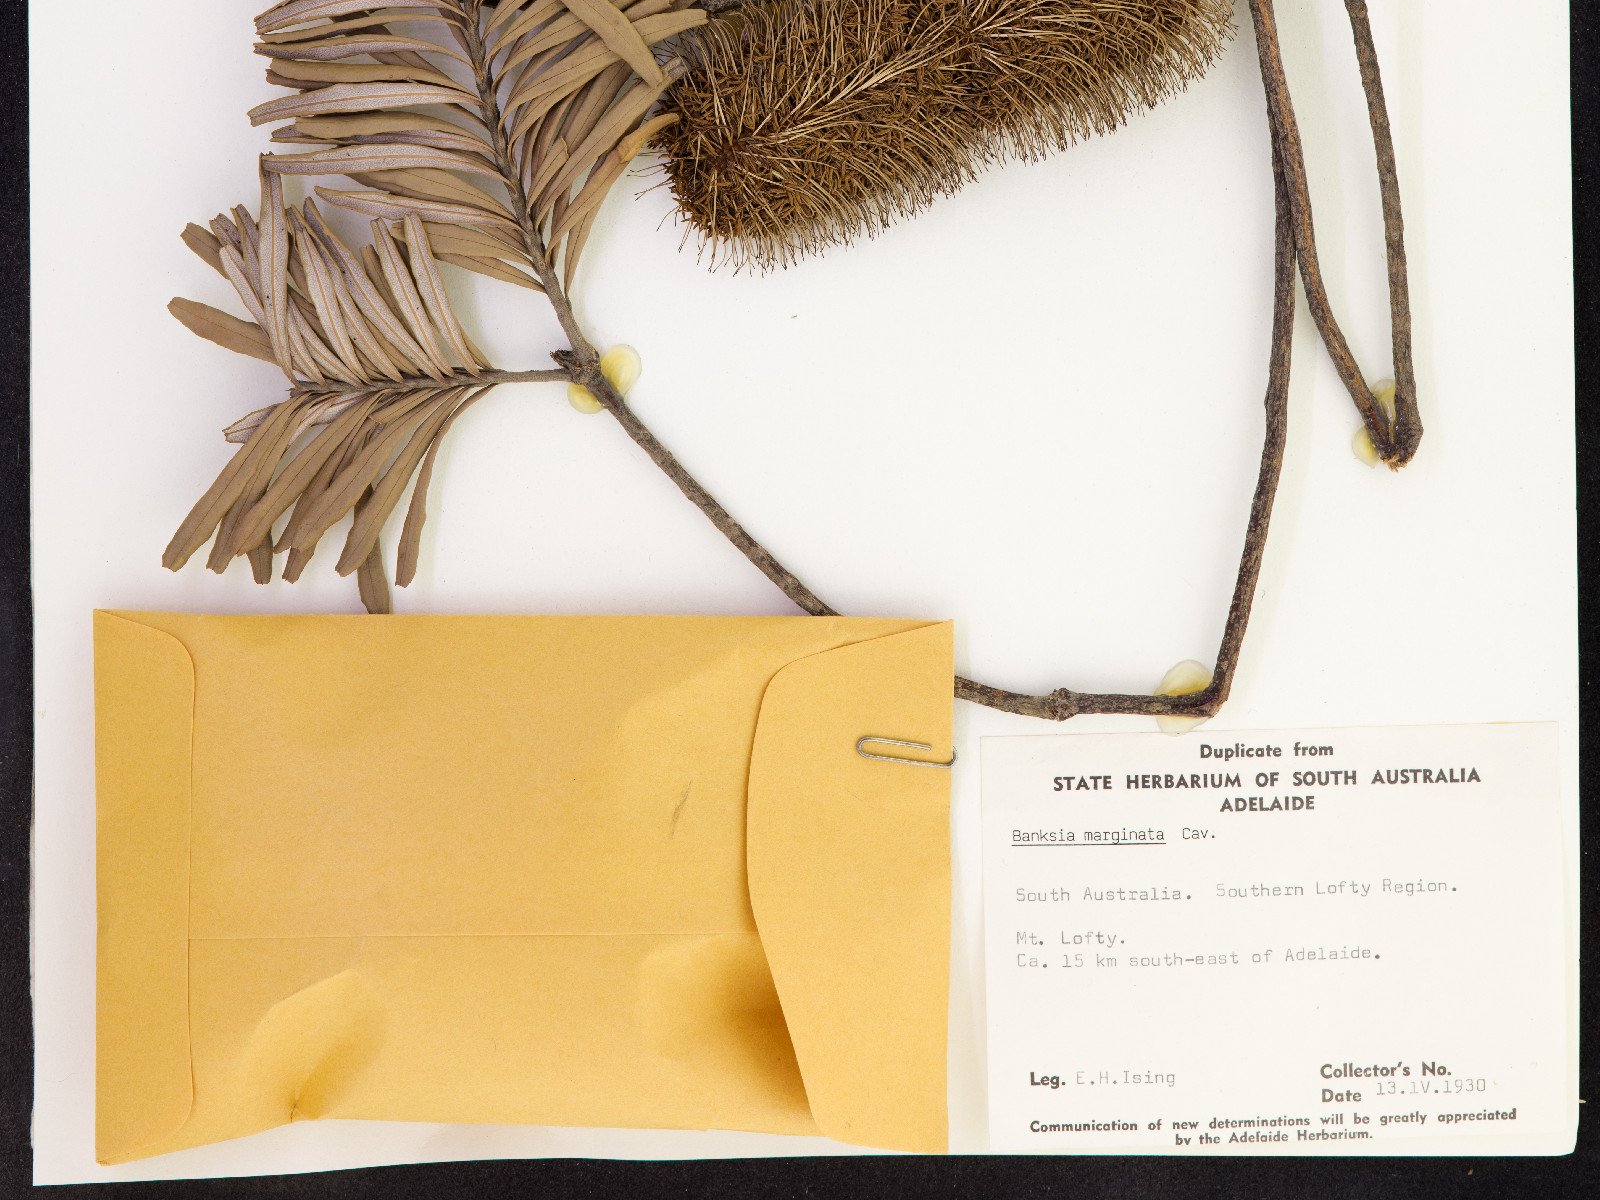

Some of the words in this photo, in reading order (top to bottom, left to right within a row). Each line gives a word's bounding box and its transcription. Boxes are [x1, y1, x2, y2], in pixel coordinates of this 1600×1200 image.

[1199, 742, 1282, 762] Duplicate
[1293, 741, 1334, 757] from
[1053, 775, 1113, 792] STATE
[1126, 772, 1242, 790] HERBARIUM
[1255, 771, 1280, 788] OF
[1292, 770, 1357, 787] SOUTH
[1370, 767, 1482, 785] AUSTRALIA
[1219, 795, 1315, 813] ADELAIDE
[1011, 828, 1077, 843] Banksia
[1082, 827, 1166, 845] marginata
[1182, 827, 1215, 840] Cav.
[1016, 887, 1070, 902] South
[1083, 886, 1192, 901] Australia.
[1216, 882, 1304, 898] Southern
[1315, 880, 1371, 900] Lofty
[1382, 878, 1458, 897] Region.
[1016, 931, 1045, 946] Mt.
[1061, 930, 1126, 949] Lofty.
[1017, 953, 1048, 969] Ca.
[1061, 953, 1084, 968] 15
[1095, 953, 1117, 968] km
[1129, 950, 1239, 967] south-east
[1251, 949, 1273, 964] of
[1285, 945, 1382, 962] Adelaide.
[1421, 1061, 1452, 1077] No.
[1029, 1071, 1067, 1090] Leg.
[1076, 1070, 1176, 1088] E.H.Ising
[1321, 1088, 1362, 1103] Date
[1029, 1119, 1138, 1133] Communication
[1147, 1118, 1163, 1131] of
[1172, 1121, 1200, 1132] new
[1208, 1115, 1312, 1131] determinations
[1319, 1113, 1345, 1127] will
[1353, 1112, 1370, 1125] be
[1379, 1110, 1428, 1127] greatly
[1437, 1107, 1517, 1125] appreciated
[1198, 1132, 1221, 1145] the
[1228, 1130, 1289, 1144] Adelaide
[1296, 1127, 1373, 1142] Herbarium.
